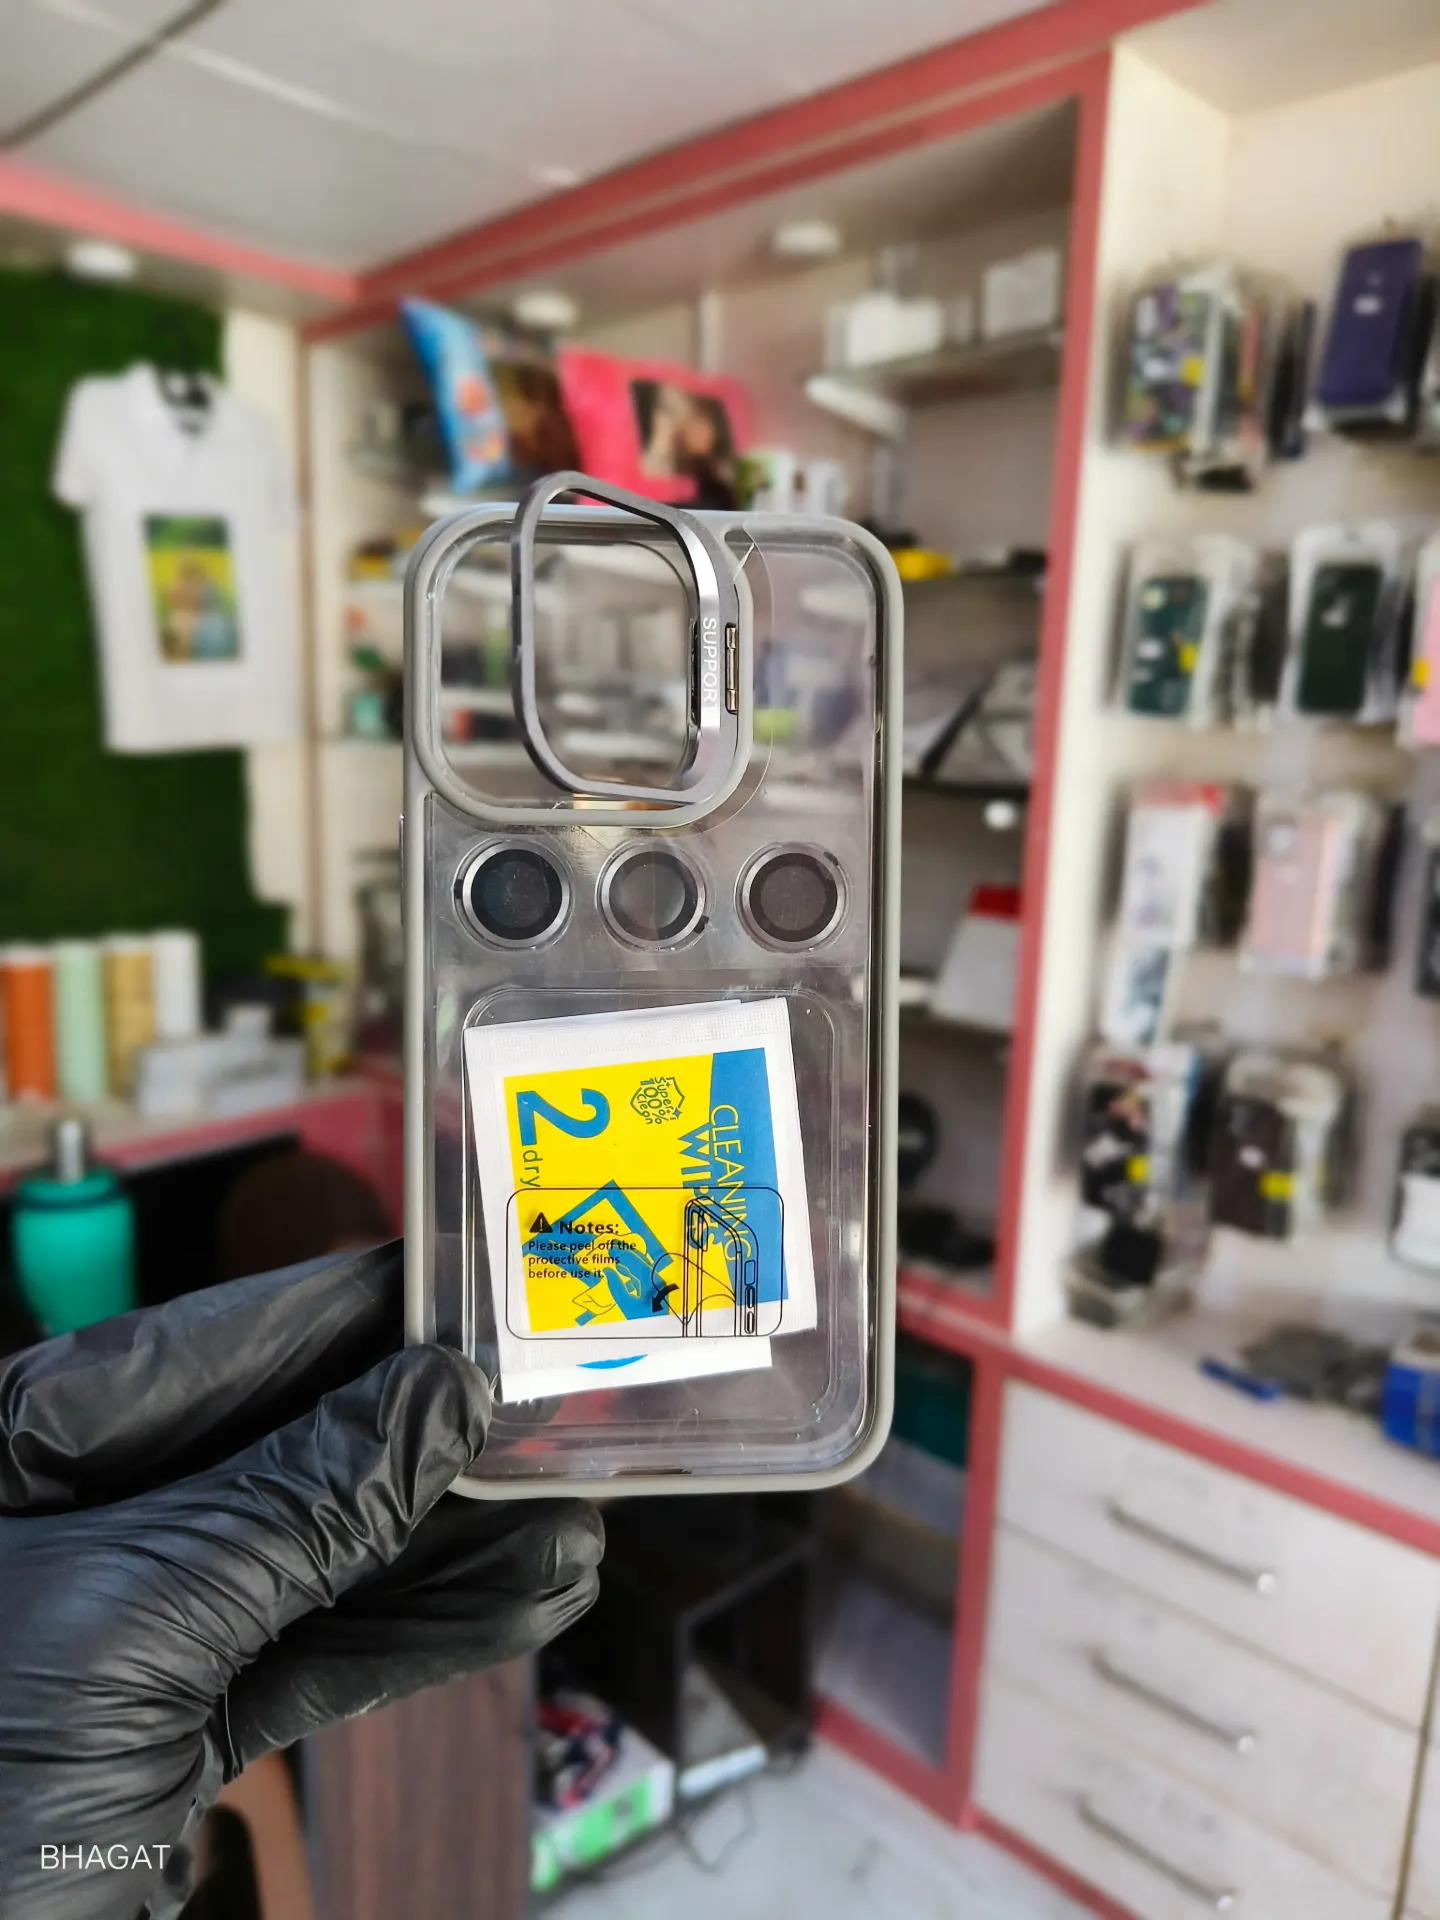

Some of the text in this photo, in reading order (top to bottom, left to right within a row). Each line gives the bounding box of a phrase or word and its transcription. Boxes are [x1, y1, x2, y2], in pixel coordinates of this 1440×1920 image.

[640, 1078, 669, 1125] 100%
[654, 1076, 674, 1110] Super
[516, 1088, 610, 1187] 2 dry
[710, 1104, 751, 1261] CLEANING
[560, 1221, 619, 1234] Notes:
[528, 1239, 637, 1254] Please peel off the
[528, 1254, 620, 1267] protective films
[528, 1268, 567, 1278] before
